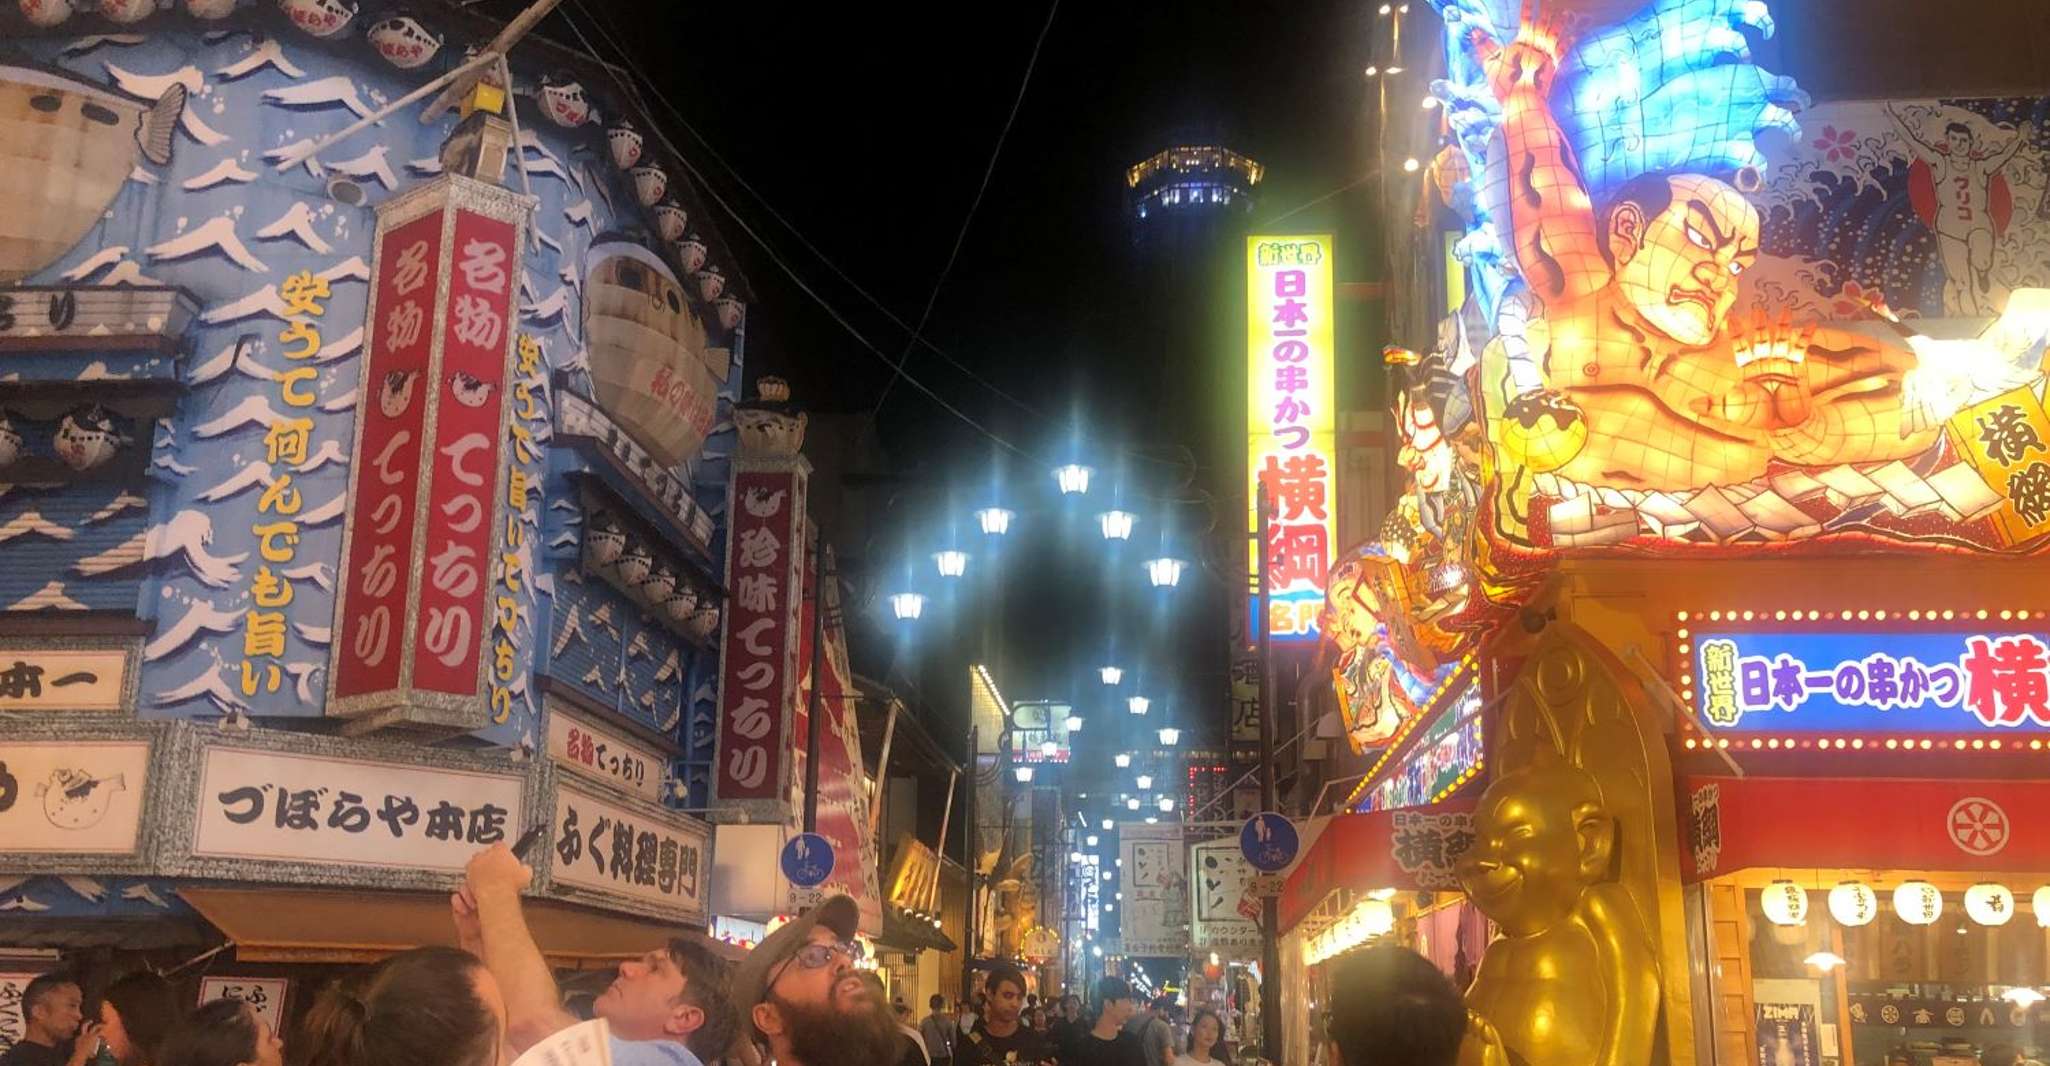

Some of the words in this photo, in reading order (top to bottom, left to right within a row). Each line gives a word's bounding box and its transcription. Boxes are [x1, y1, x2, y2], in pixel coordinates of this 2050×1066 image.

[1272, 270, 1310, 449] 日本一の串かつ
[241, 269, 332, 696] 安うて何んでも旨い
[354, 430, 411, 667] てっちり
[425, 432, 490, 667] てっちり
[1258, 454, 1327, 591] 横綱
[729, 527, 782, 789] 珍味てっちり
[1705, 643, 1736, 722] 新世界
[1741, 658, 1959, 707] 日本一の串かつ
[218, 783, 508, 845] づぼらや本店
[556, 804, 699, 899] ふぐ料理専門
[1763, 1005, 1800, 1020] ZIMA
